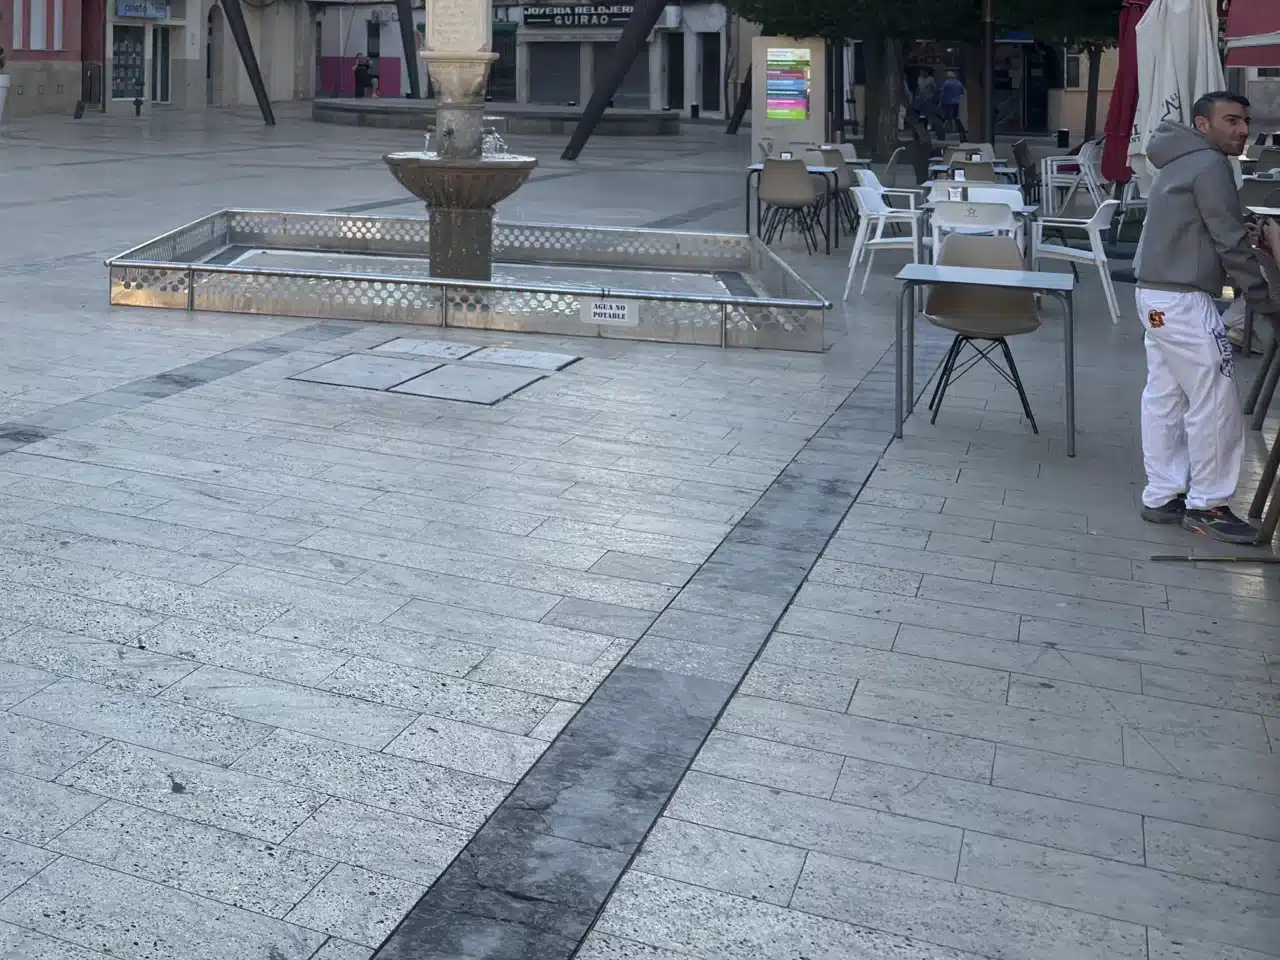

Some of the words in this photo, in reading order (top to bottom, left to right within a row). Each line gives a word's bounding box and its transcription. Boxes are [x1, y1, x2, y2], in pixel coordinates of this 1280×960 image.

[574, 5, 634, 14] RELOJERI
[554, 15, 609, 25] GUIRAO
[593, 303, 613, 311] AGUA
[593, 311, 626, 320] POTABLE
